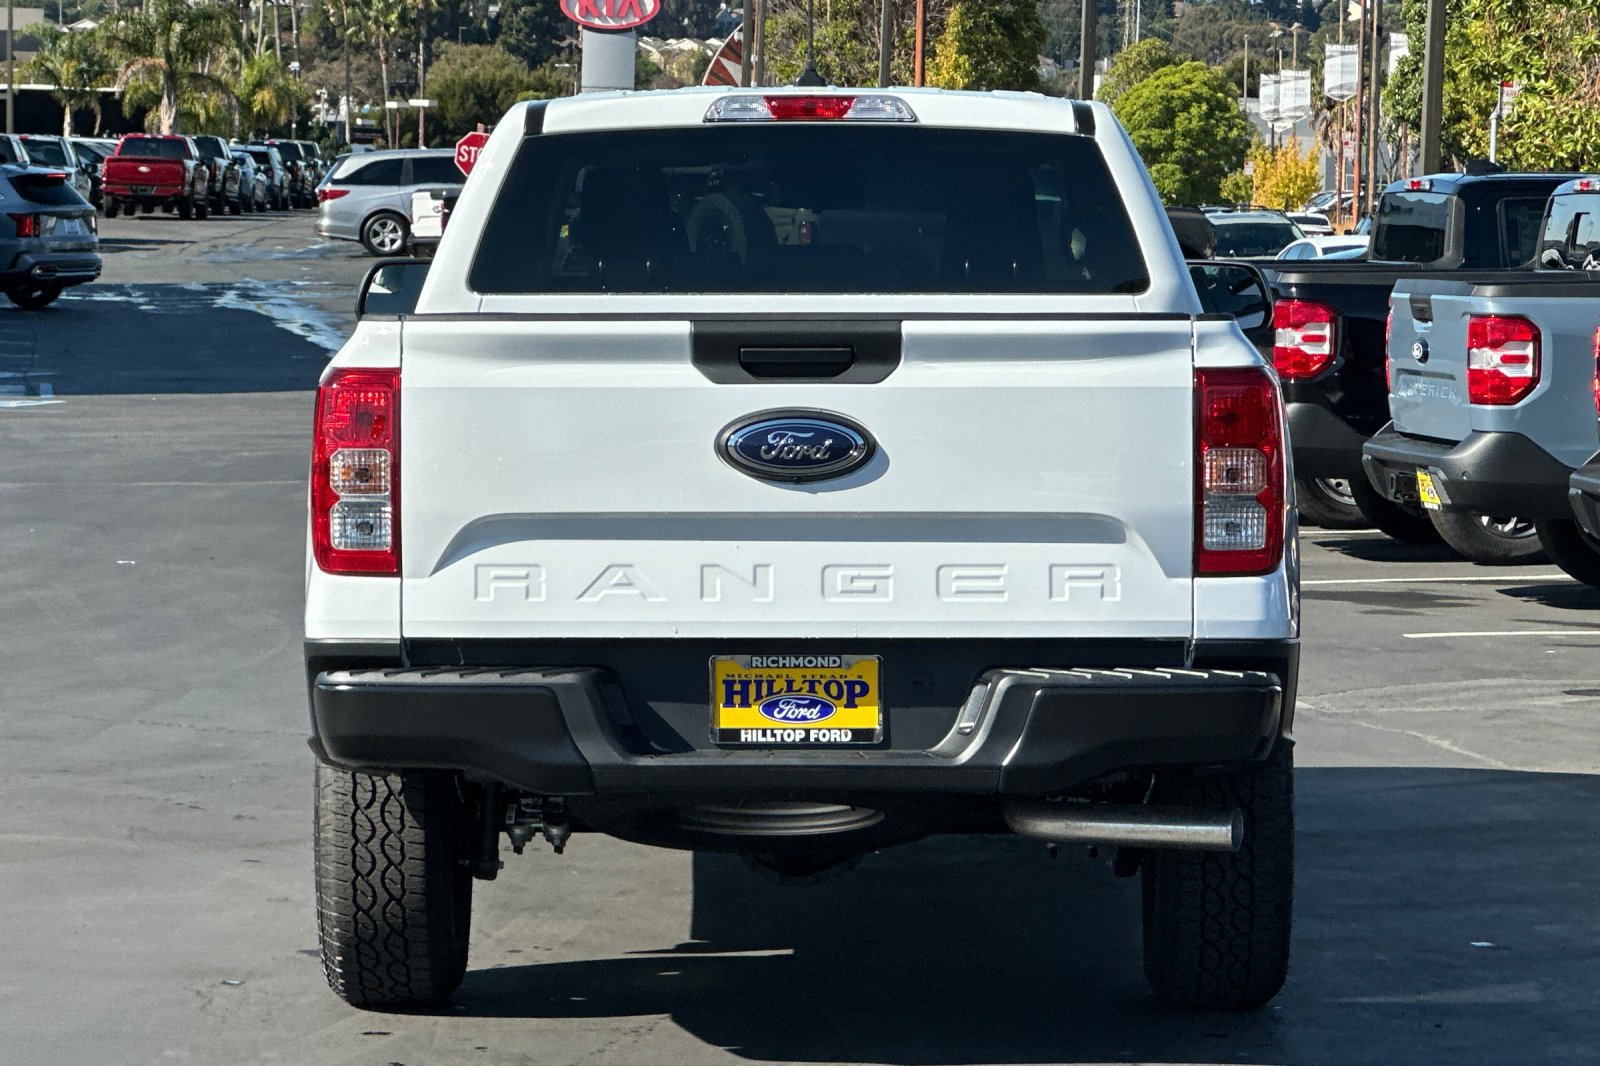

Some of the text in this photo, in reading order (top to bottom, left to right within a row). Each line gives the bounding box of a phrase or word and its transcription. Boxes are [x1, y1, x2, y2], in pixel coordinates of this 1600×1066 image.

[458, 145, 484, 163] ST
[760, 430, 832, 460] Ford
[473, 563, 1122, 602] RANGER
[751, 656, 841, 668] RICHMOND
[722, 679, 870, 709] HILLTOP
[773, 698, 821, 720] Ford
[740, 729, 852, 742] HILLTOP FORD
